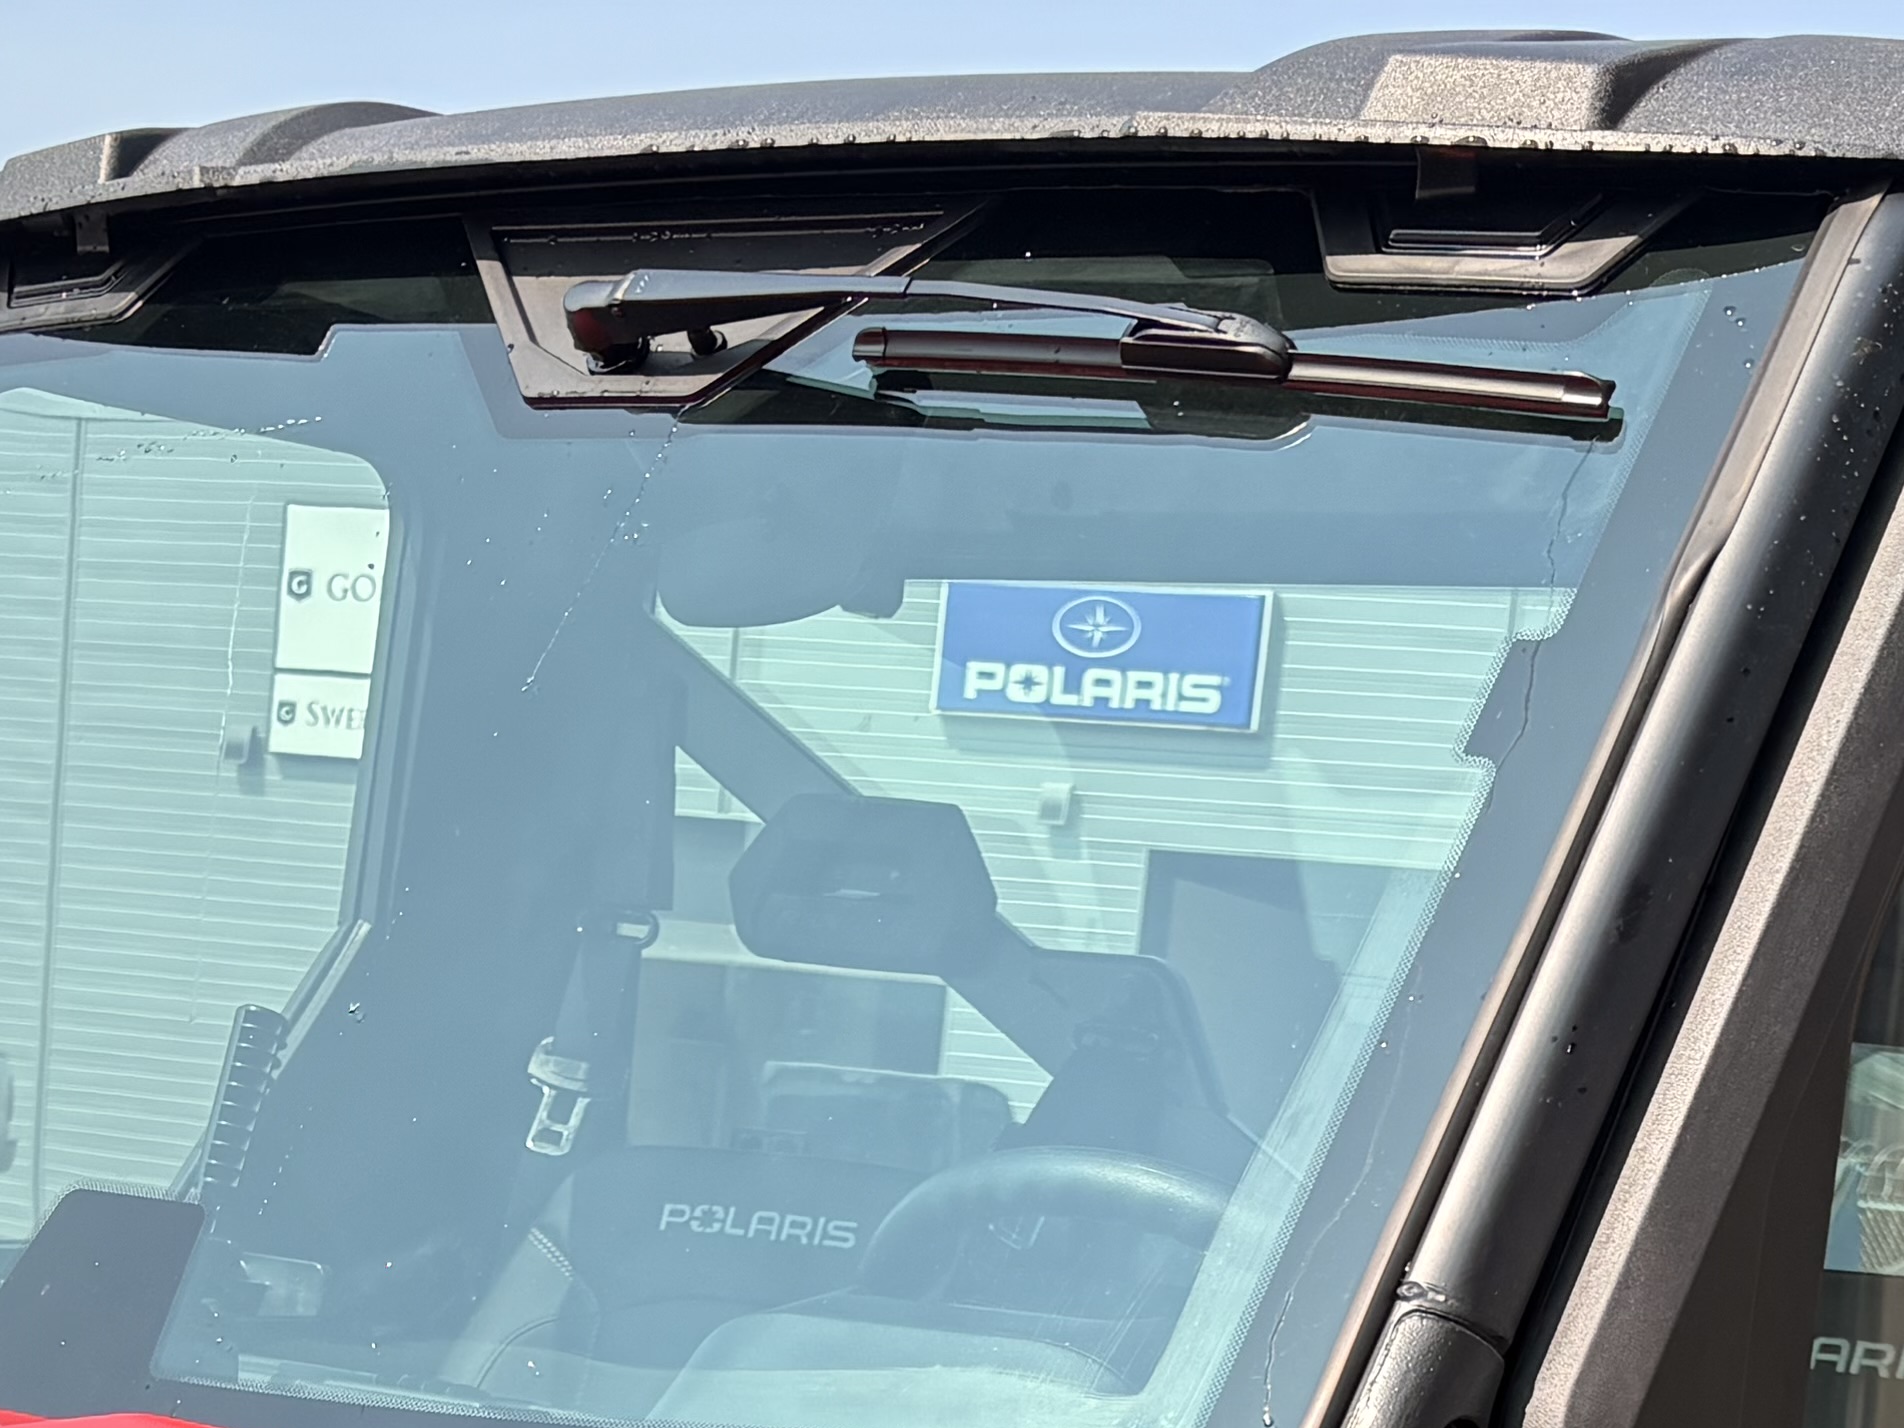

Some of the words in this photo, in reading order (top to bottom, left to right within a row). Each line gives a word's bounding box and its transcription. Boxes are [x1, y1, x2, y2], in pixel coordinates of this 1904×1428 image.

[326, 573, 377, 602] GO
[962, 660, 1224, 715] POLARIS
[658, 1203, 859, 1250] POLARIS
